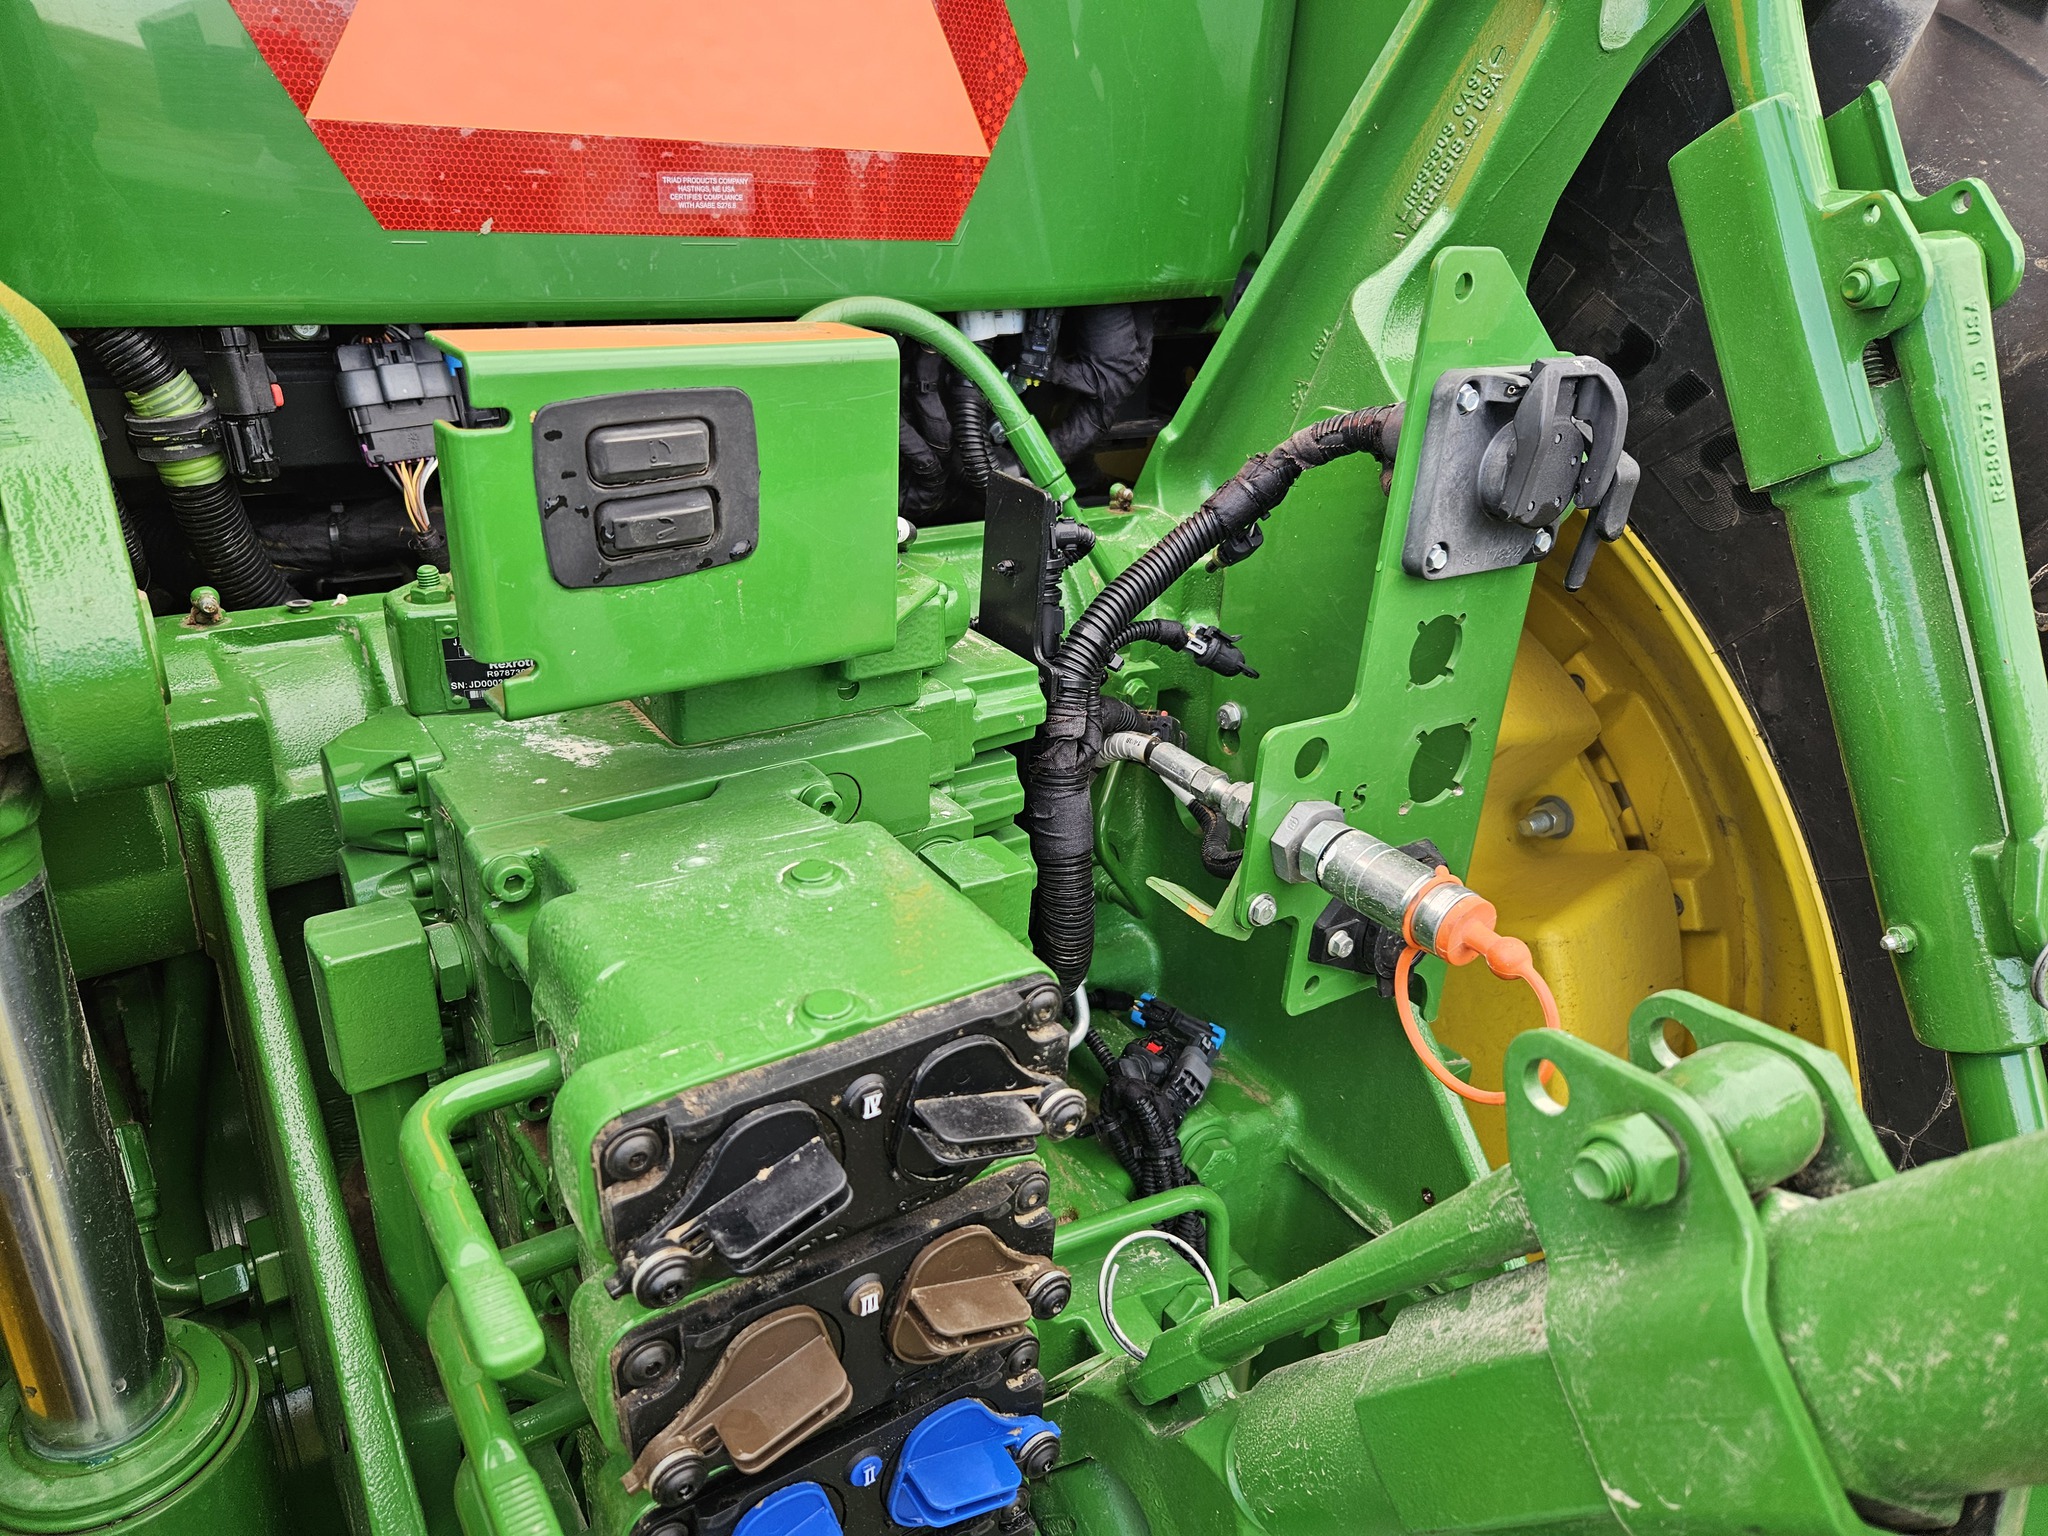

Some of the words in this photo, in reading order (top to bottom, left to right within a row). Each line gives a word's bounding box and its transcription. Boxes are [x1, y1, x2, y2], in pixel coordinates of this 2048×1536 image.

[1473, 72, 1504, 111] USA
[662, 176, 682, 184] TRIAD
[718, 177, 749, 185] COMPANY
[677, 185, 710, 193] HASTINGS,
[670, 193, 702, 201] CERTIFIES
[703, 193, 743, 201] COMPLIANCE
[678, 201, 695, 209] WITH
[695, 201, 715, 209] ASABE
[862, 1090, 884, 1120] IV
[860, 1293, 880, 1317] III
[863, 1465, 877, 1487] II
